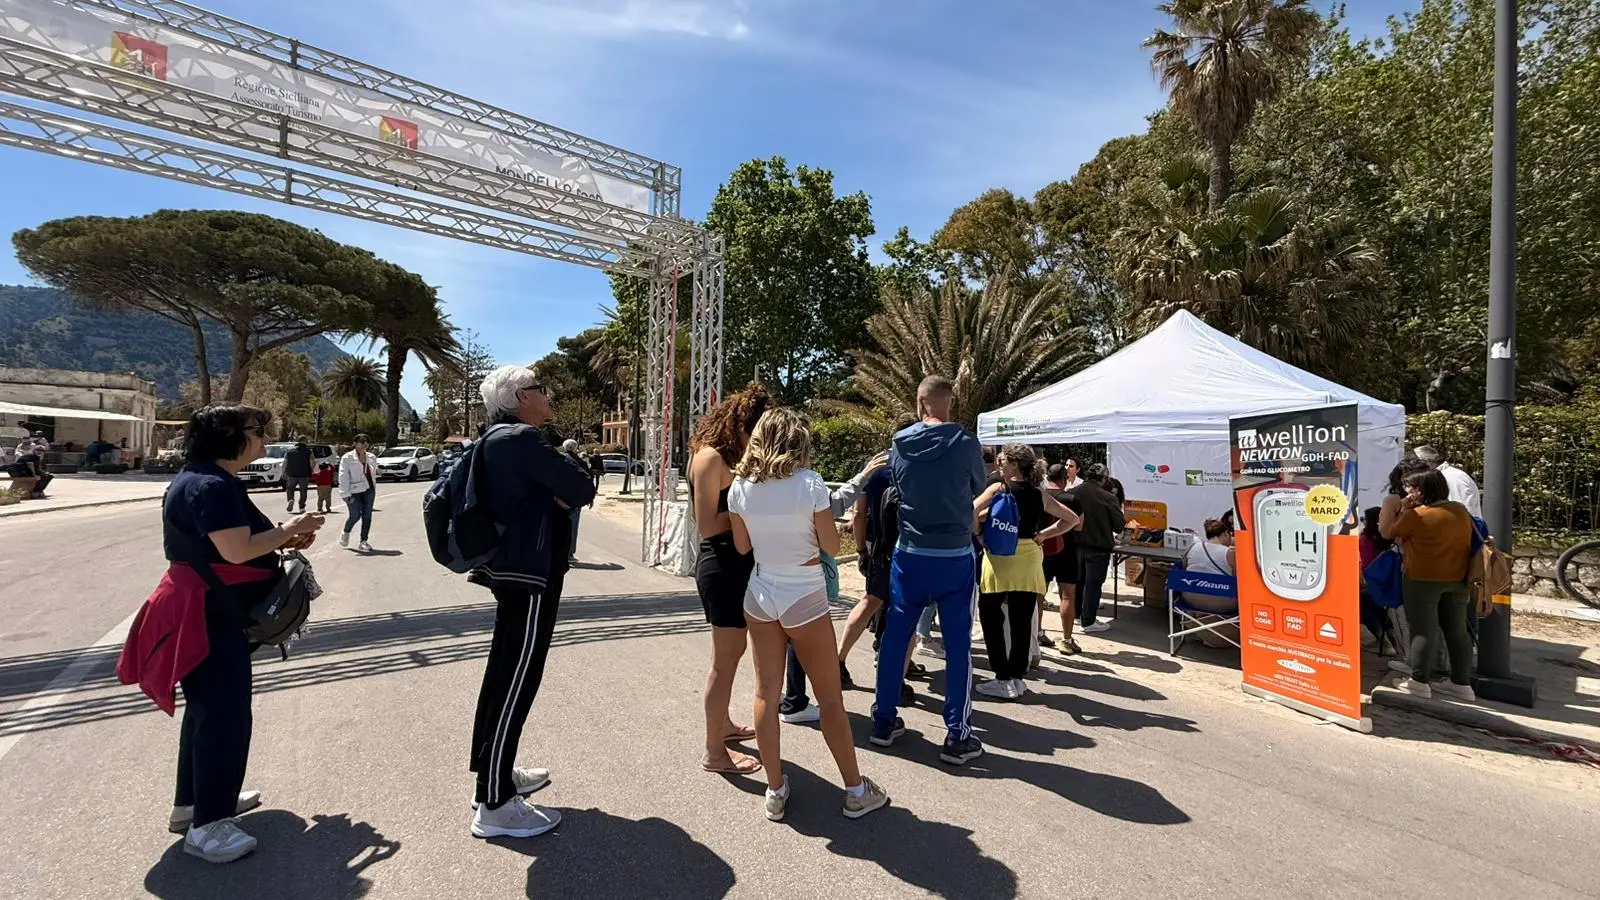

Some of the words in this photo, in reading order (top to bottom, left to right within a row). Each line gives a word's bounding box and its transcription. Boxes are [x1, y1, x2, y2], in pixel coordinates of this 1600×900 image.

[234, 77, 276, 96] Regione
[279, 88, 320, 108] Siciliana
[231, 92, 284, 112] Assessorato
[285, 104, 322, 121] Turismo
[1258, 424, 1346, 447] wellion
[1239, 446, 1303, 461] NEWTON
[1301, 451, 1349, 462] GDH-FAD
[1267, 465, 1311, 474] GLUCOMETRO
[1310, 507, 1341, 515] MARD
[1254, 617, 1272, 625] CODE
[1287, 622, 1302, 631] FAD
